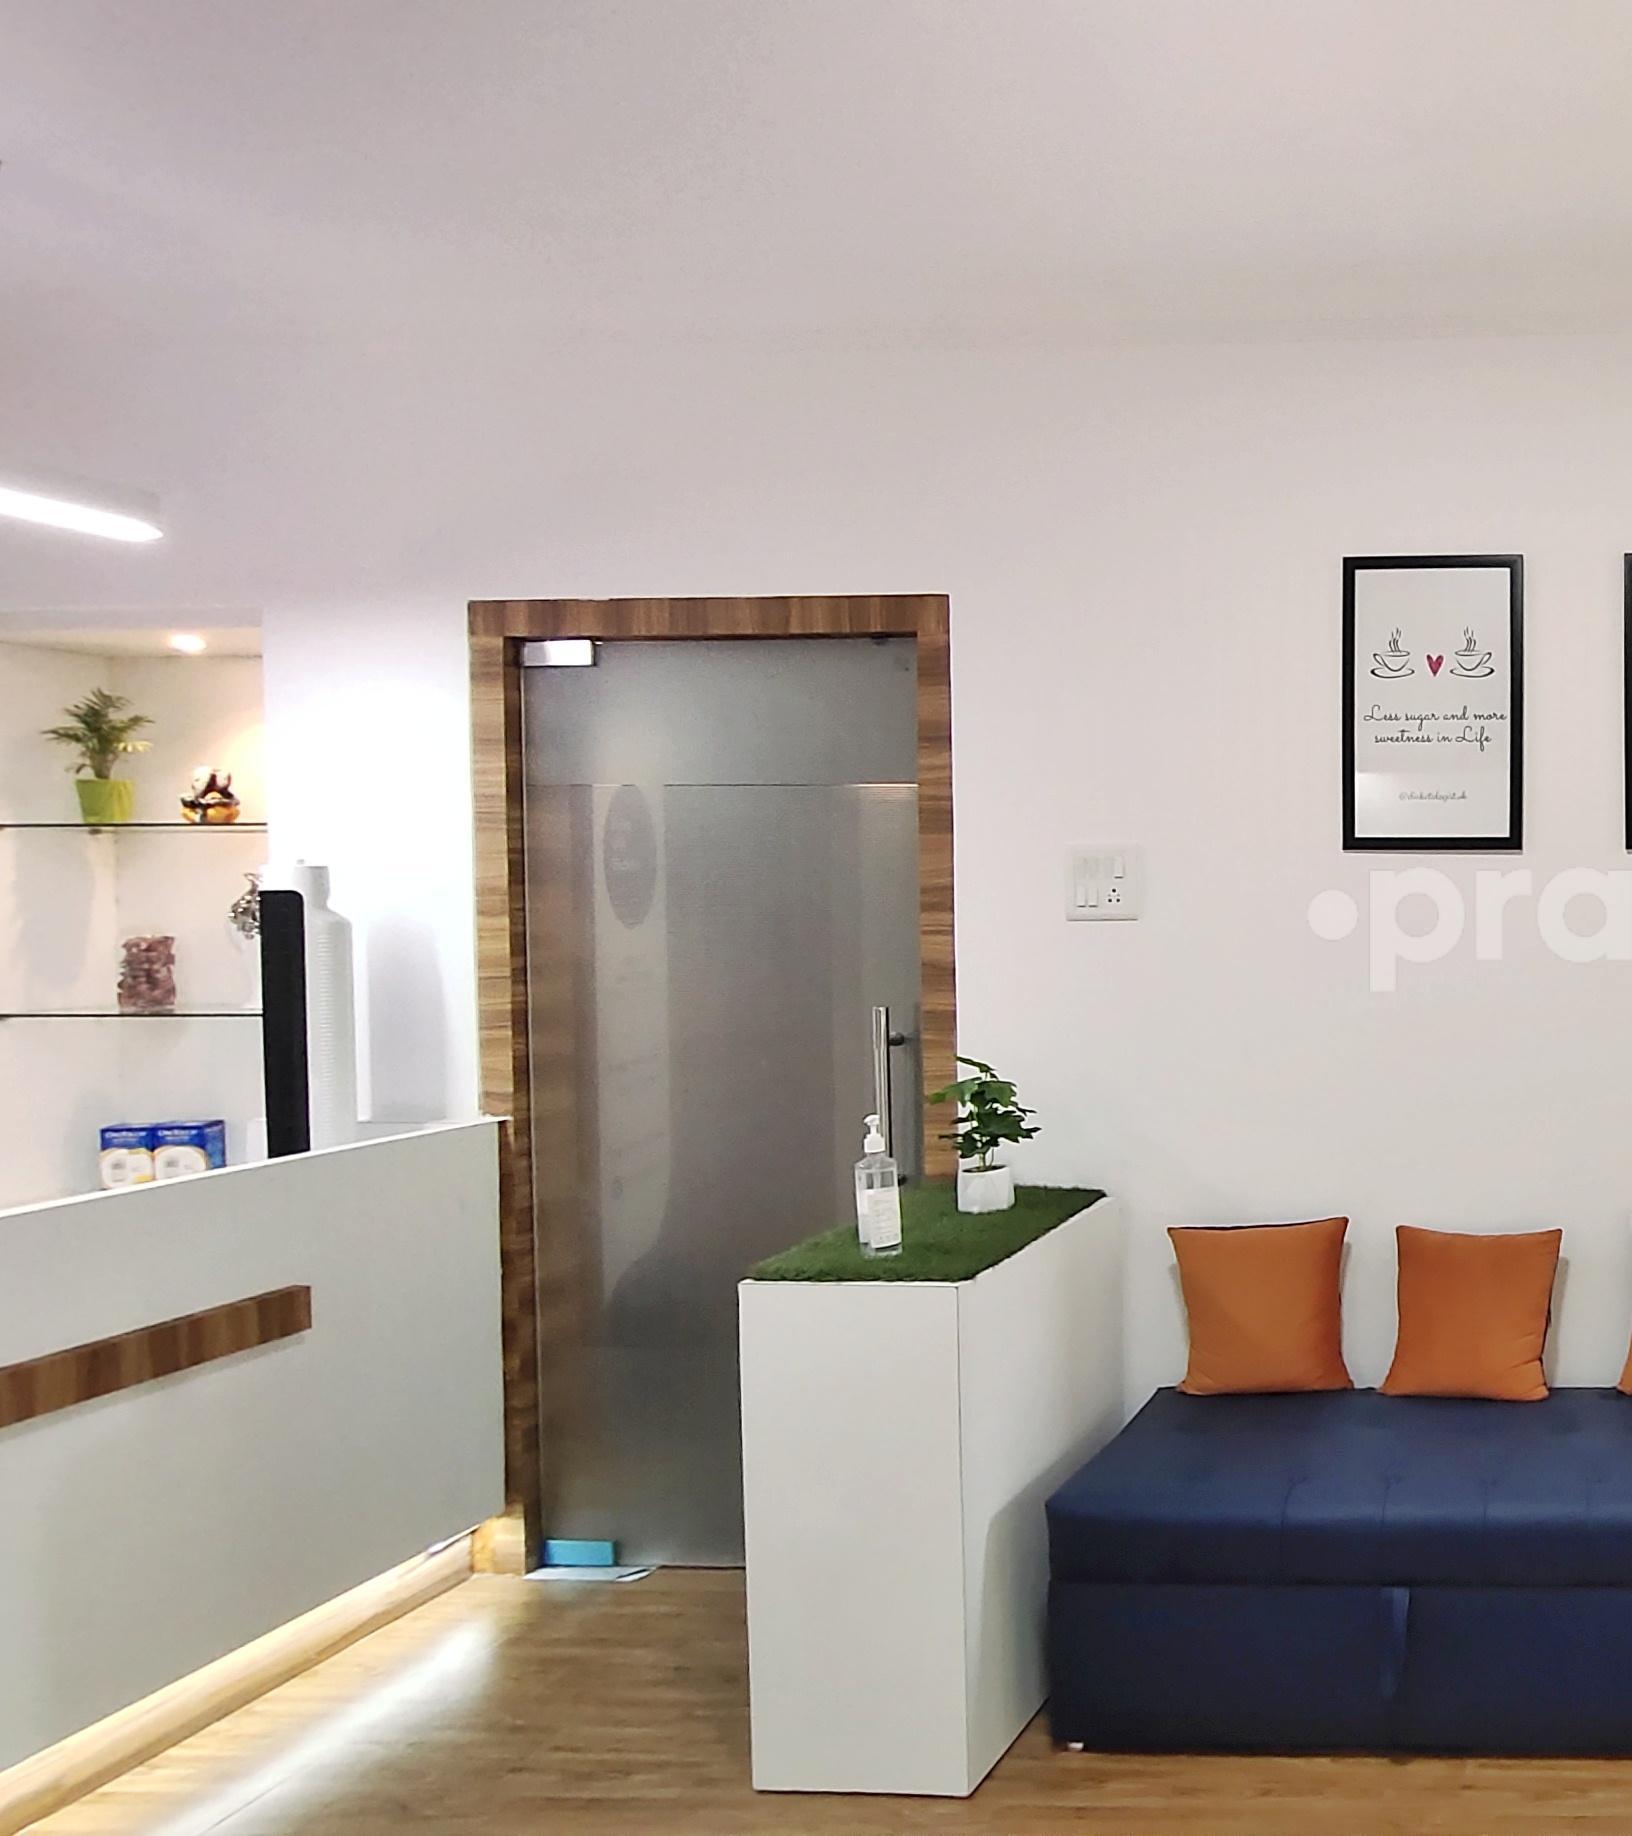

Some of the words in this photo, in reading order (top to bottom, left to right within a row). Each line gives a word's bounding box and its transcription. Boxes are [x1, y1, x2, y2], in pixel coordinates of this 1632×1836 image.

[1363, 704, 1401, 722] Less
[1405, 712, 1439, 731] sugar
[1443, 705, 1469, 722] and
[1473, 712, 1507, 722] more
[1374, 729, 1433, 744] sweetness
[1437, 730, 1452, 743] in
[1455, 726, 1492, 752] Life
